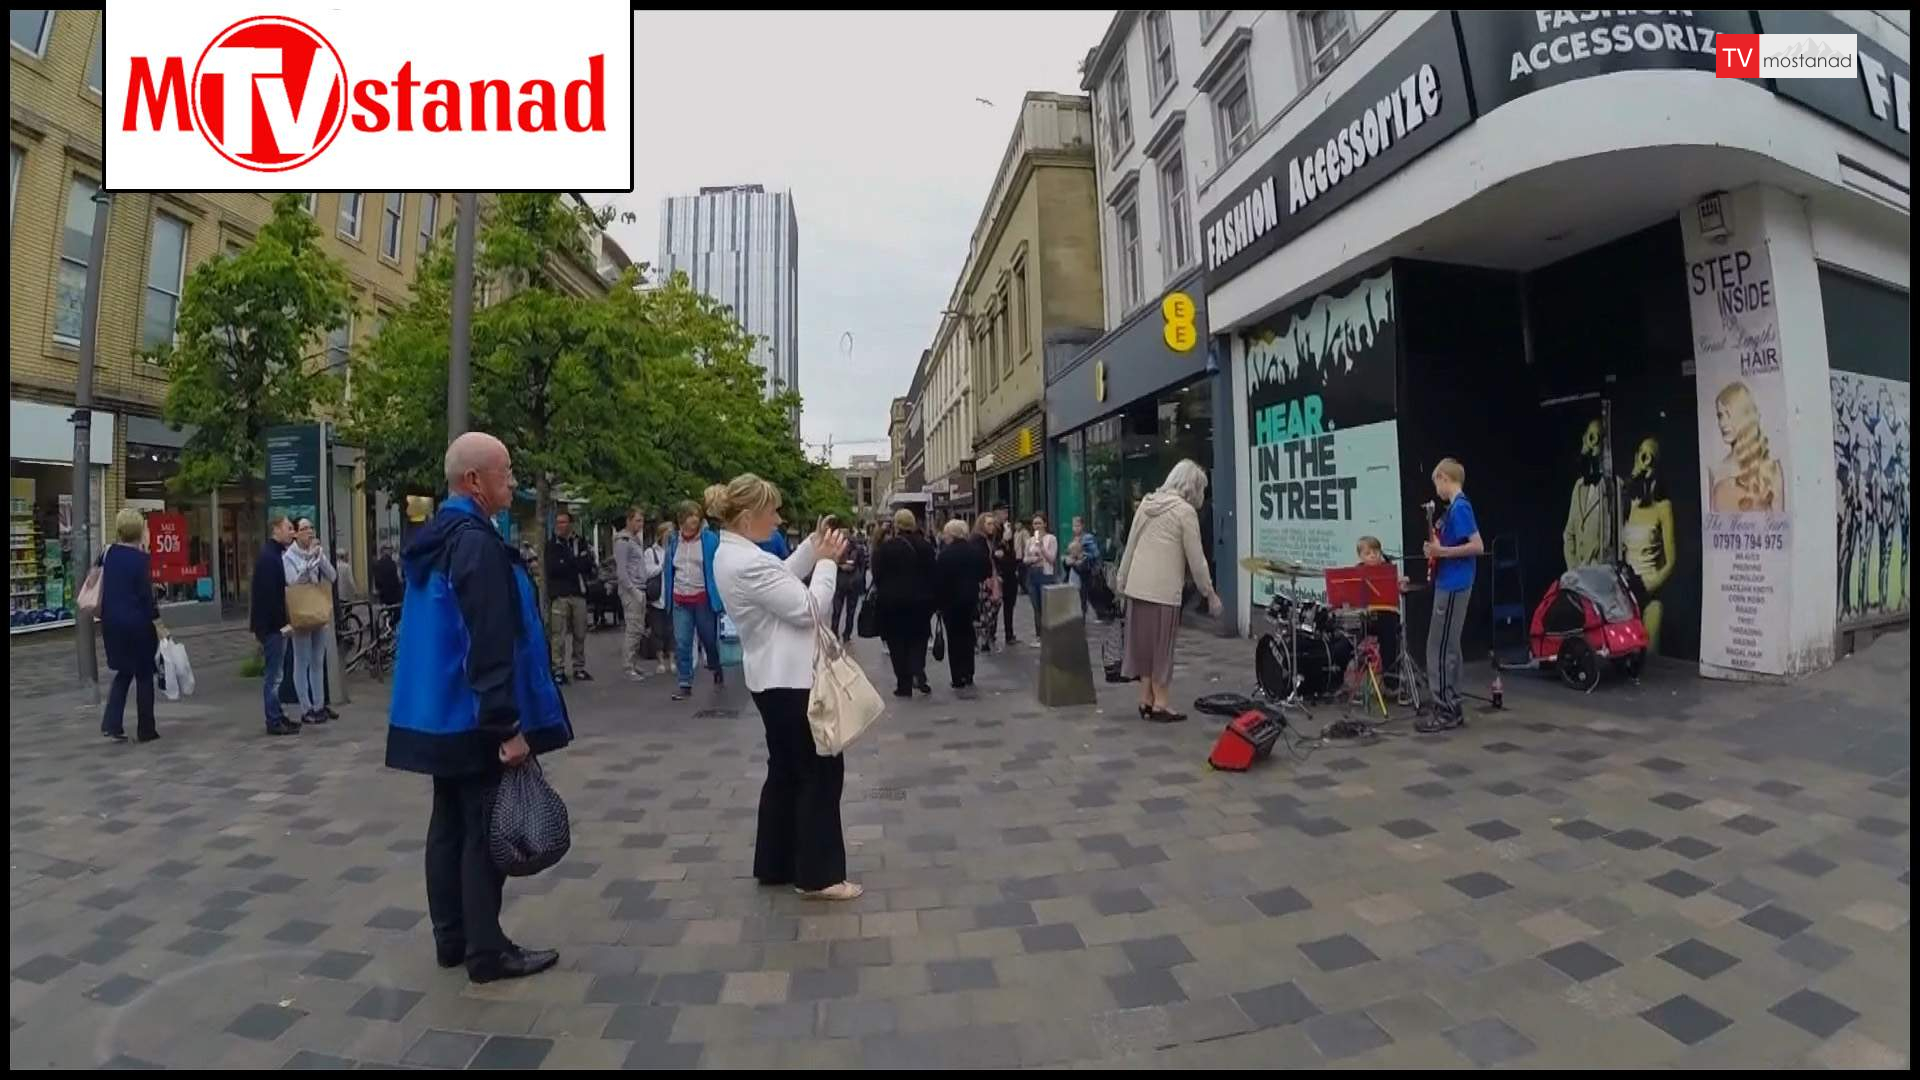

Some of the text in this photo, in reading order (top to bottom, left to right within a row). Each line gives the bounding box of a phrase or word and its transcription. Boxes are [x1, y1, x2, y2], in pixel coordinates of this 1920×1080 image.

[1509, 23, 1724, 81] ACCESSORIZ
[1206, 64, 1440, 272] FASHION Accessorize
[1691, 250, 1751, 296] STEP
[1717, 280, 1770, 318] INSIDE
[1740, 348, 1778, 372] HAIR
[1256, 394, 1324, 447] HEAR
[1258, 434, 1337, 482] IN THE
[1260, 477, 1357, 521] STREET
[1713, 534, 1783, 550] 07979 794 975
